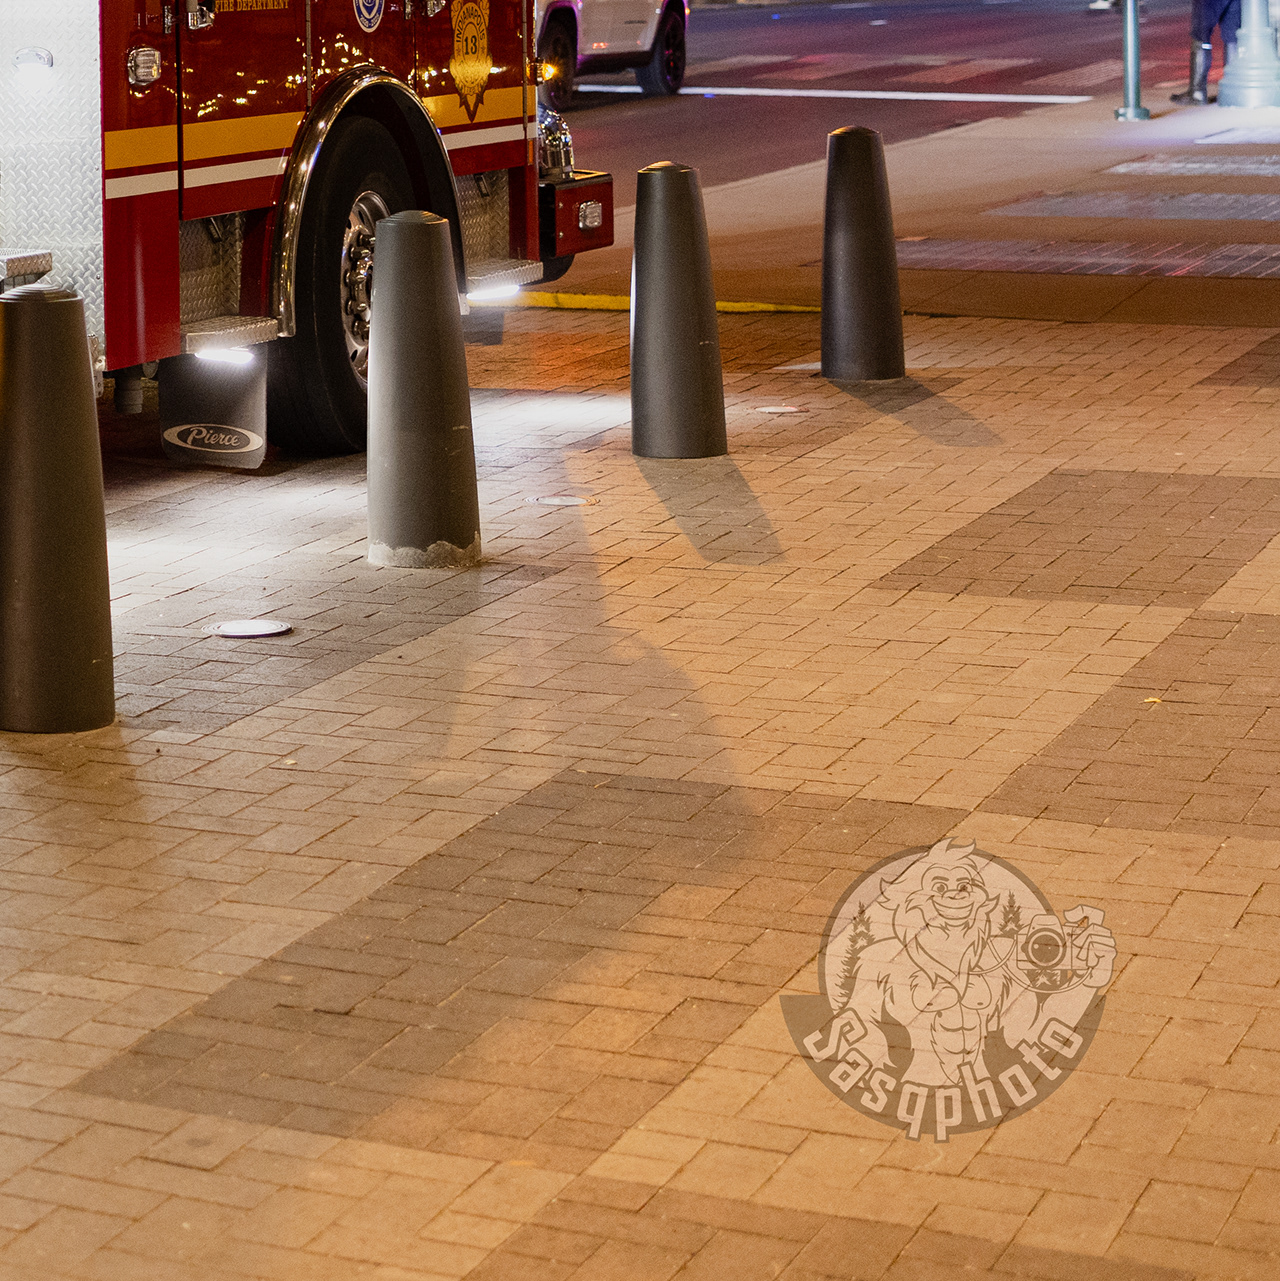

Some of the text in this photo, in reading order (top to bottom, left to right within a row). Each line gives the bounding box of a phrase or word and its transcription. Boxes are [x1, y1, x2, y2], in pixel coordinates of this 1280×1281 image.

[214, 0, 235, 13] FIRE
[455, 6, 486, 43] INDIANAPOLIS
[463, 34, 478, 56] 13
[186, 425, 241, 447] Pierce
